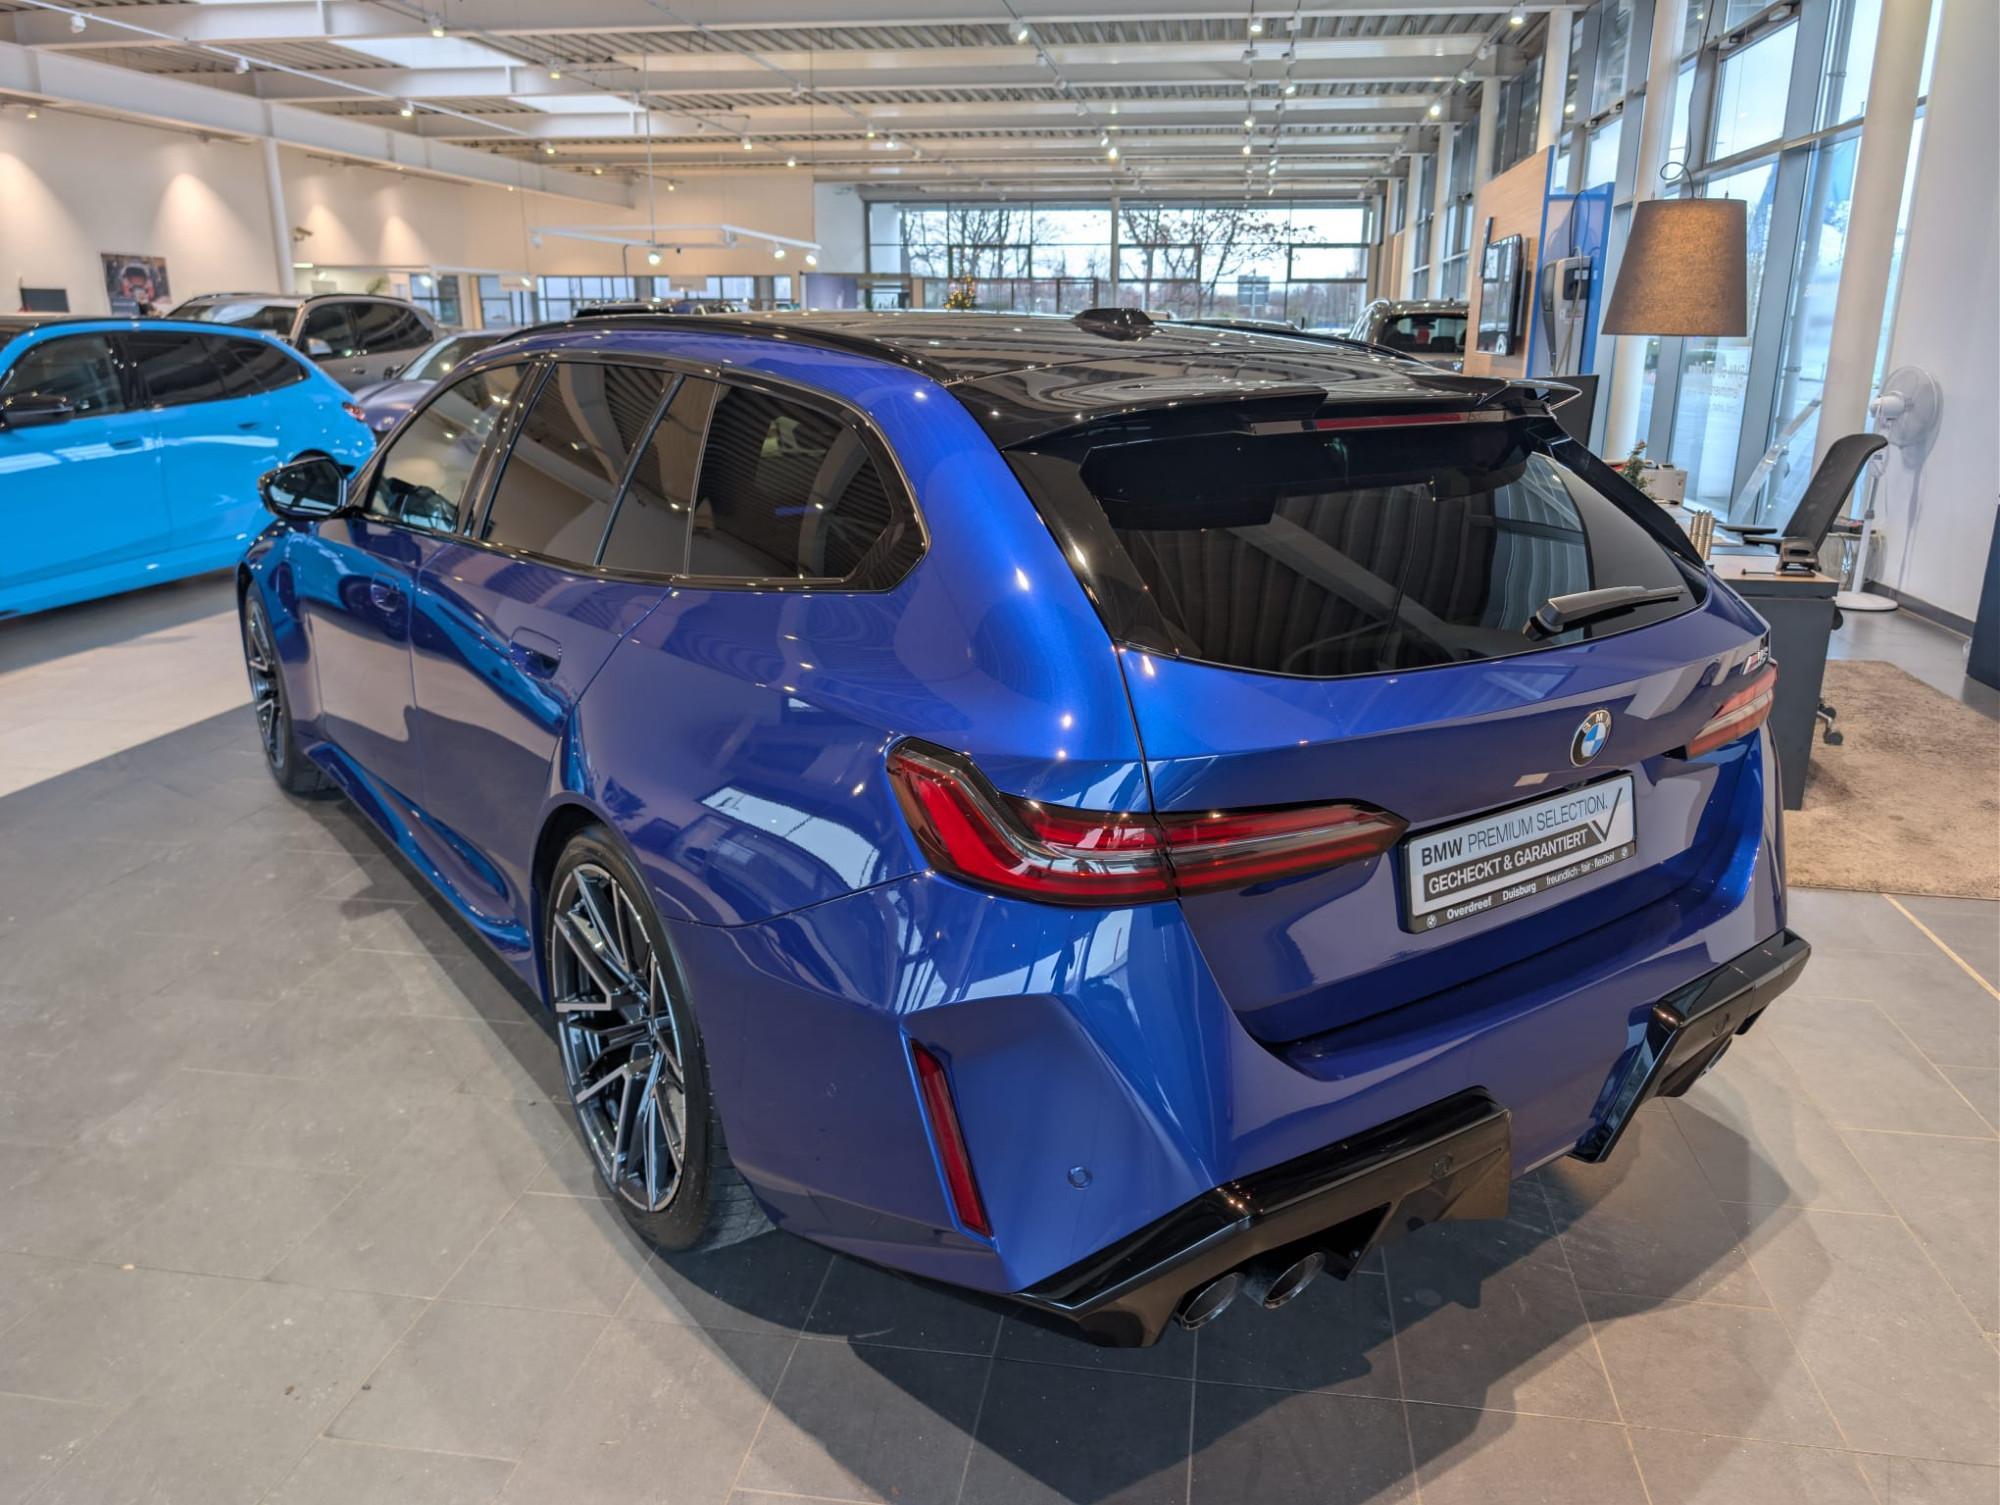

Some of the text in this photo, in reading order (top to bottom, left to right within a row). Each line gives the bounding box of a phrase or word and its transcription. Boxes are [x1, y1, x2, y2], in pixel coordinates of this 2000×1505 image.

[1422, 837, 1463, 867] BMW
[1468, 818, 1533, 851] PREMIUM
[1429, 830, 1587, 895] GECHECKT & GARANTIERT
[1503, 882, 1537, 901] Duisburg
